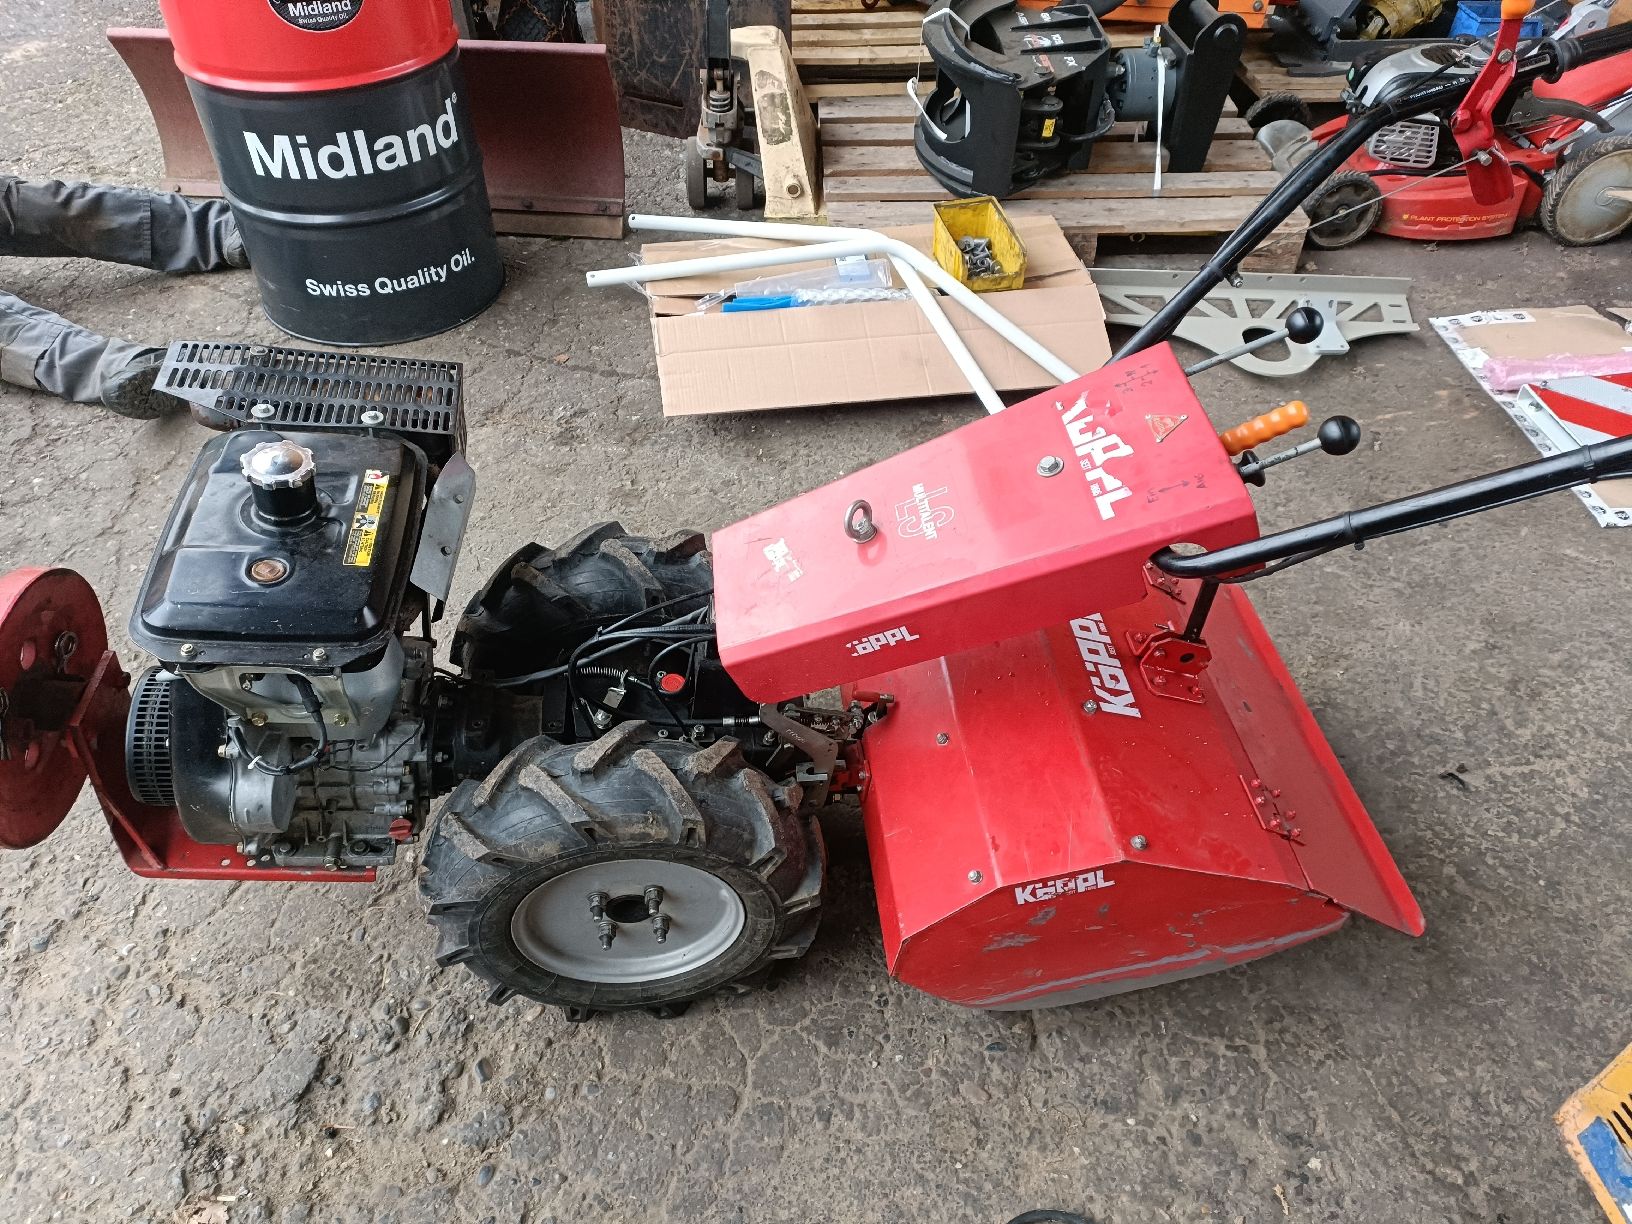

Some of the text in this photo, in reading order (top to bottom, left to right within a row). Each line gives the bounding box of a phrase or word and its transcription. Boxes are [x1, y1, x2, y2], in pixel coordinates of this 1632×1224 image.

[287, 0, 352, 17] Midland
[305, 247, 476, 298] Swiss Quality Oil.
